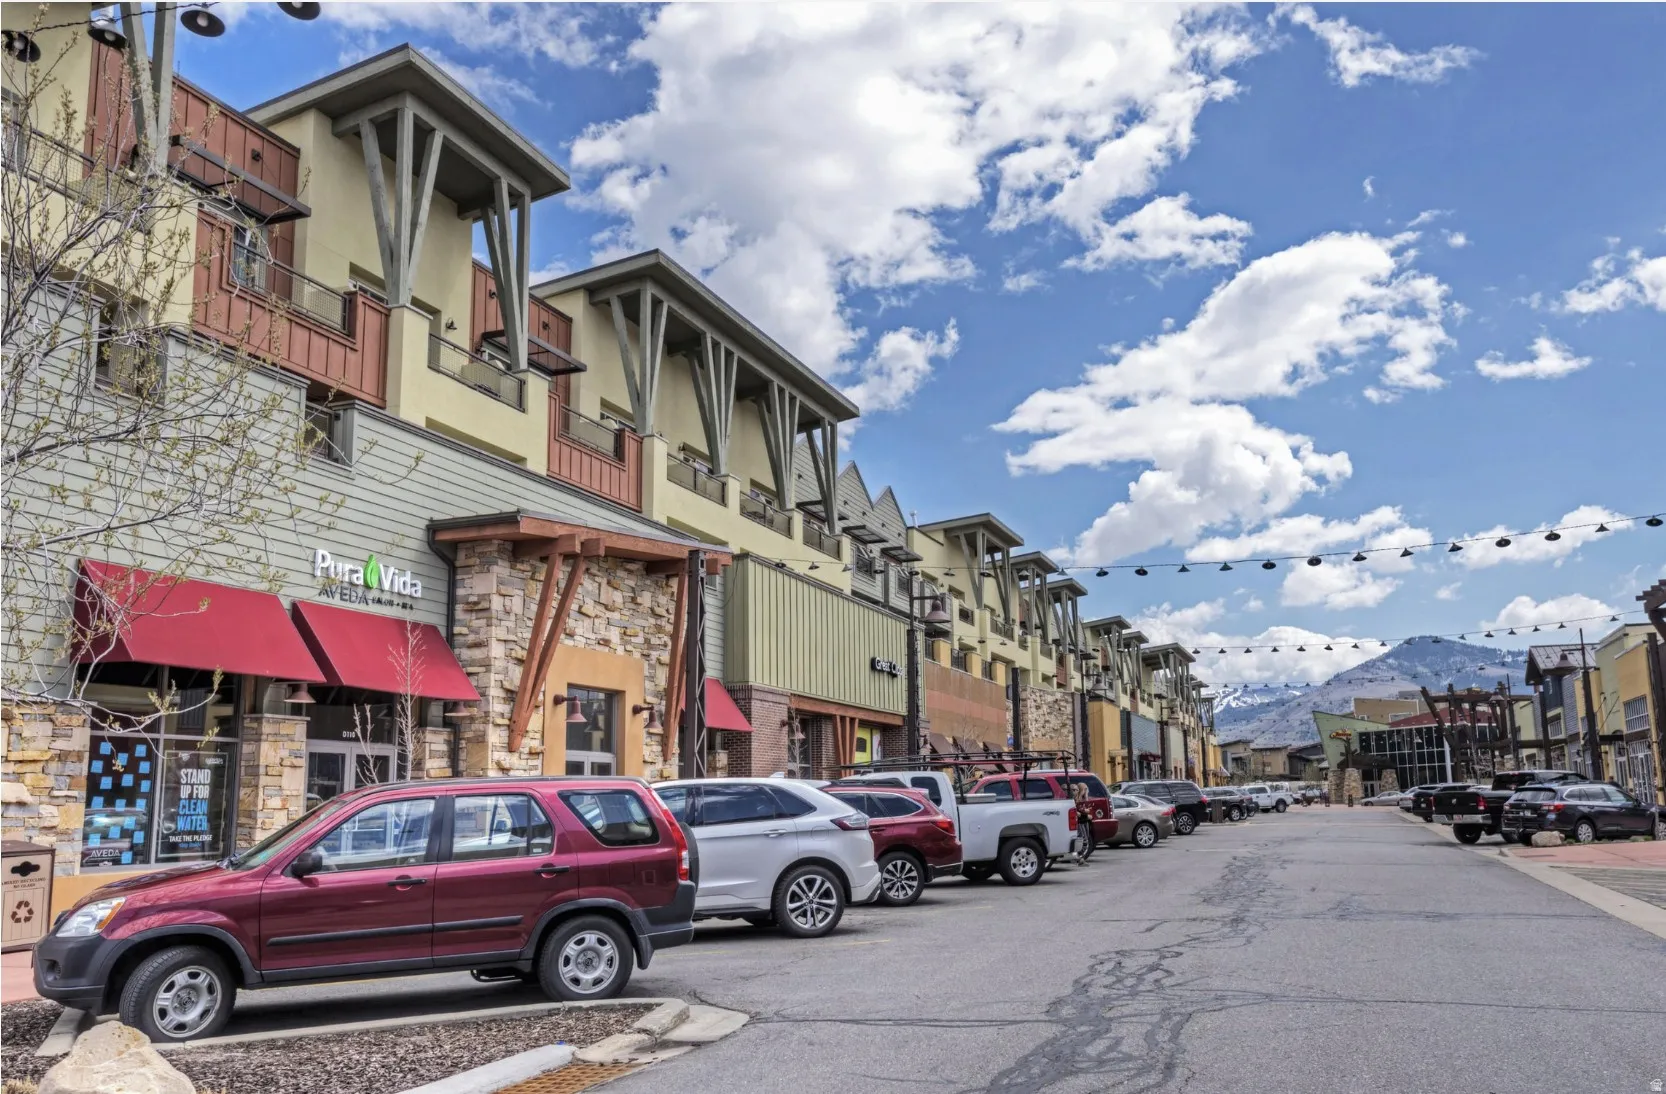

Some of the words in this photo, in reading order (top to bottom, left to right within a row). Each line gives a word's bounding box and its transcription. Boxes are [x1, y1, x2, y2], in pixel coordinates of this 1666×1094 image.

[314, 549, 364, 585] Pura
[379, 564, 422, 597] Vida
[318, 585, 369, 606] AVEDA
[180, 768, 211, 784] STAND
[180, 785, 192, 798] UP
[193, 785, 210, 799] FOR
[179, 799, 208, 815] CLEAN
[177, 815, 208, 832] WATER
[183, 834, 193, 842] THE
[194, 834, 213, 842] PLEDGE
[90, 849, 120, 857] AVEDA
